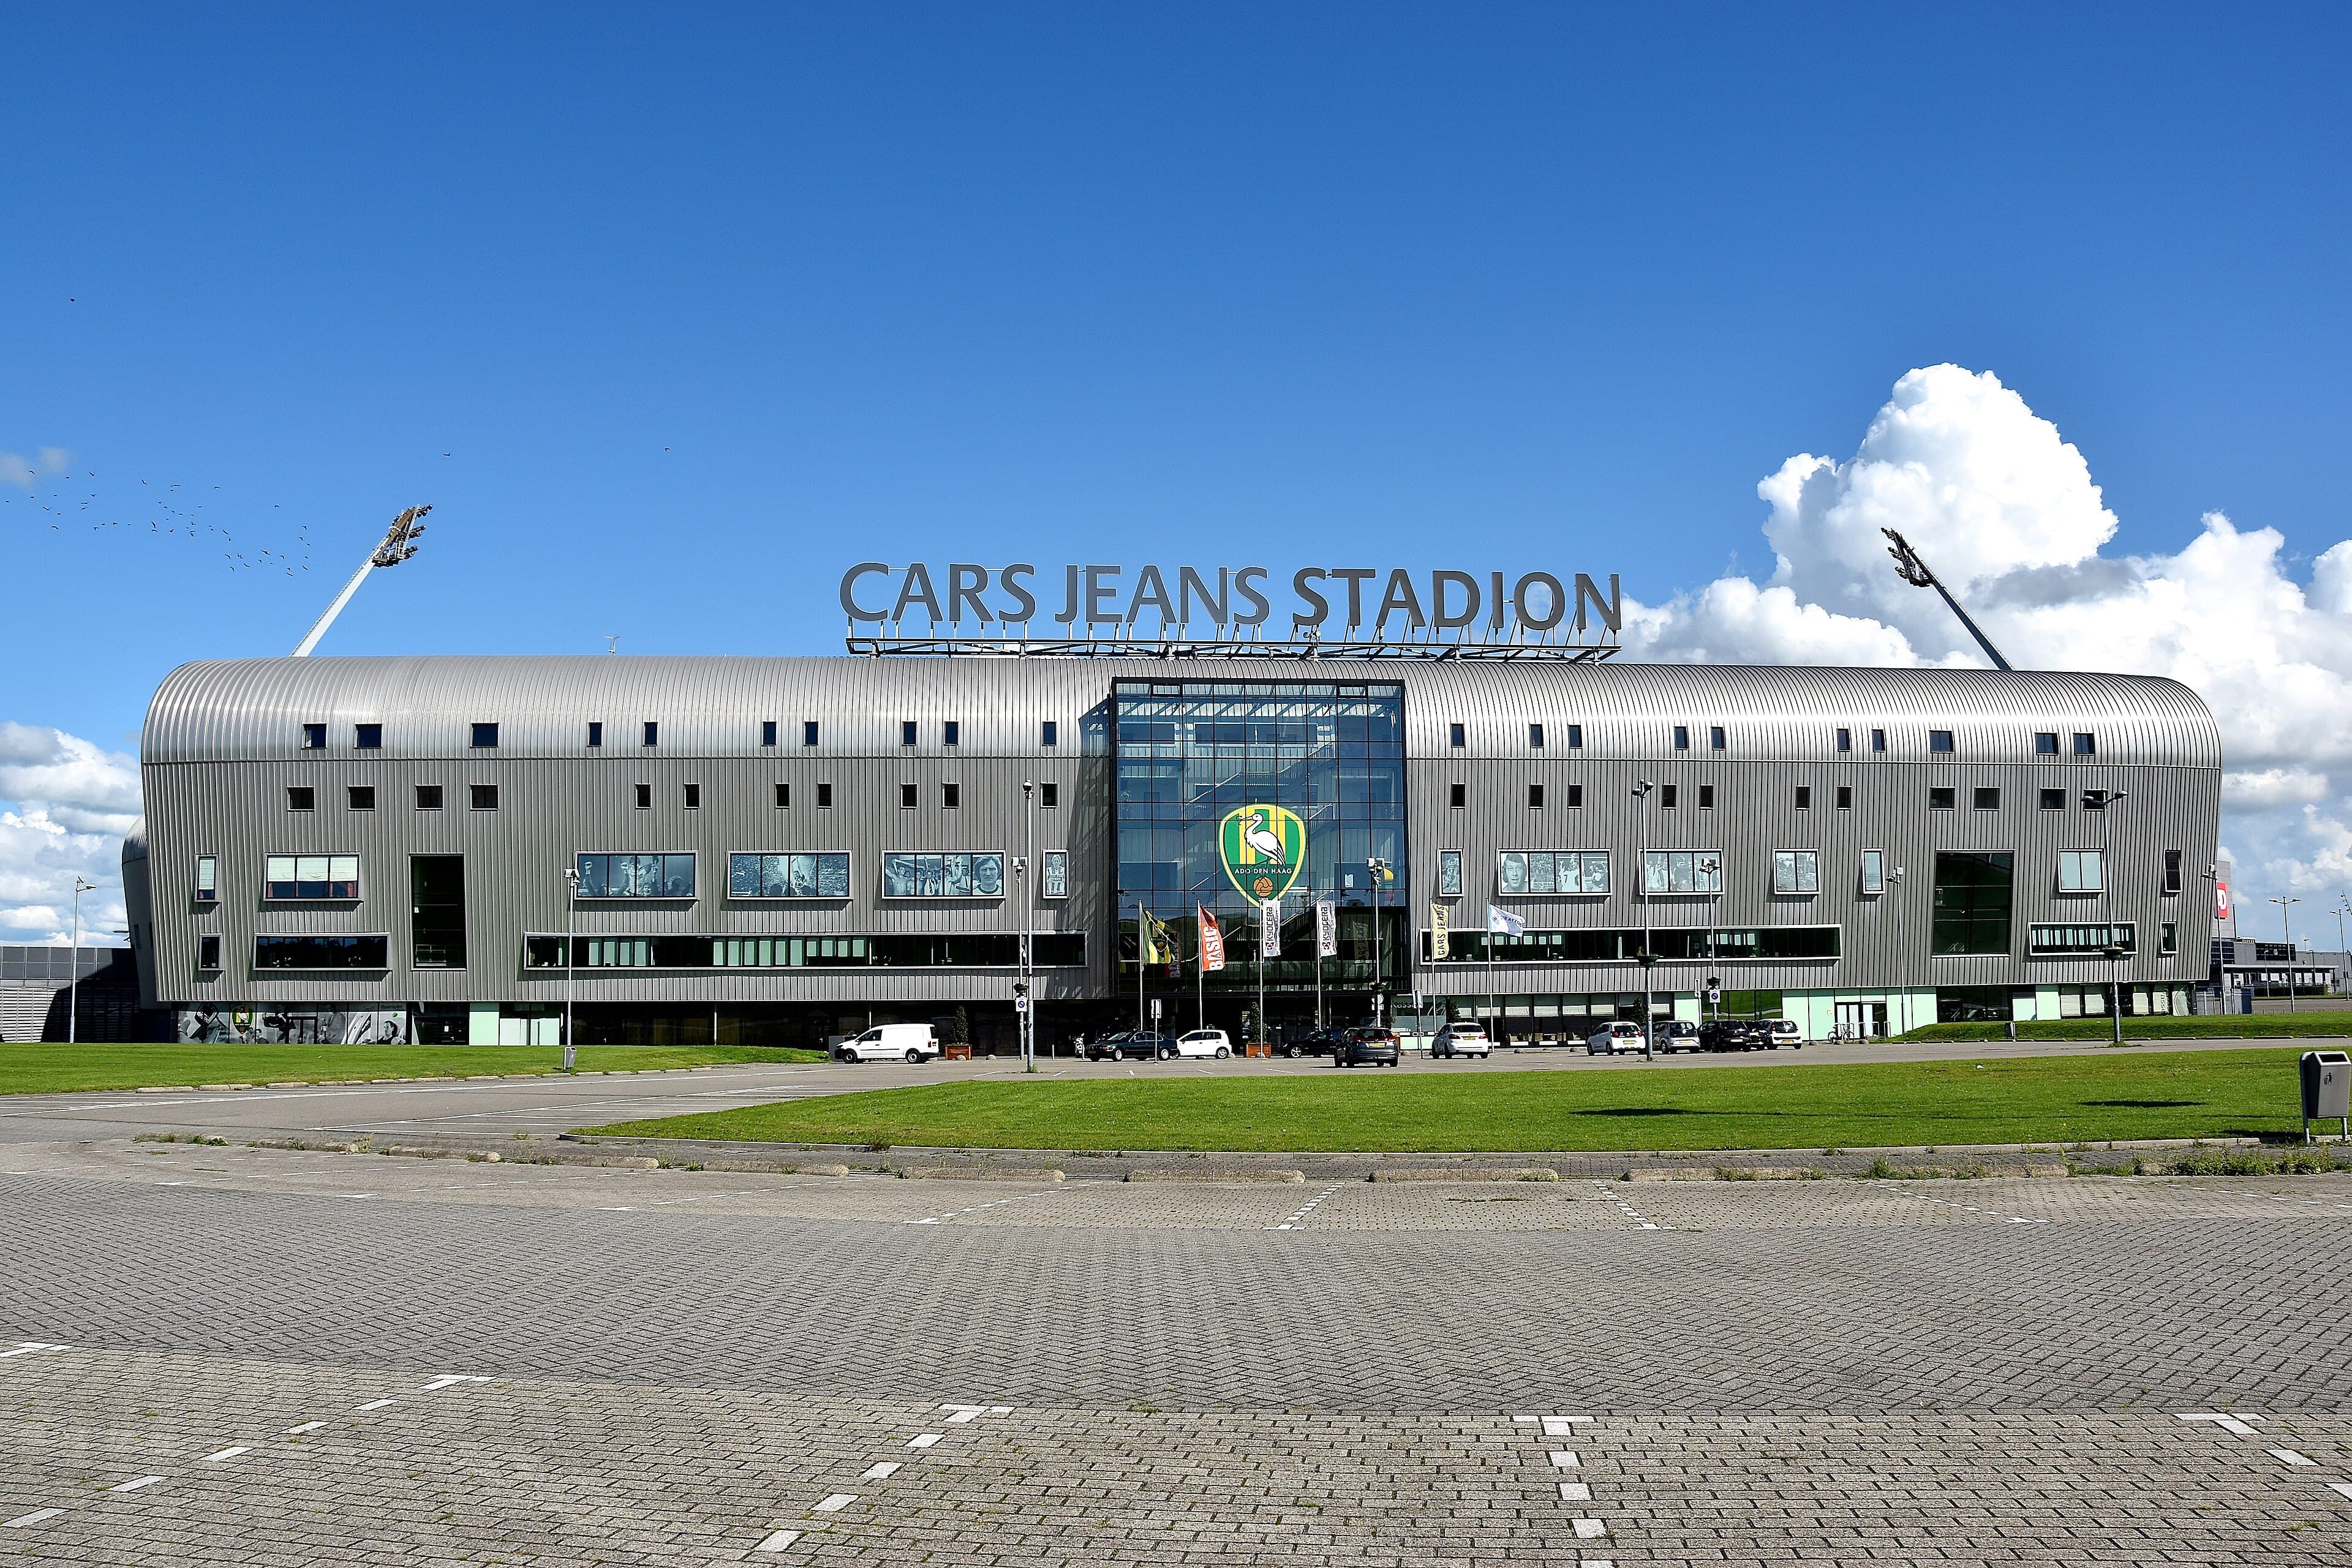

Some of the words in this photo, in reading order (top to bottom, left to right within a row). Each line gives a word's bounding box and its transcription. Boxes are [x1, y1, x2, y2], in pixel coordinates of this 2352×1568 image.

[839, 562, 1036, 622] CARS
[1054, 564, 1270, 625] JEANS
[1292, 567, 1621, 631] STADION
[1321, 907, 1329, 941] KYOCERA
[1437, 905, 1446, 930] JEANS
[1203, 926, 1224, 970] BASIC
[1437, 933, 1446, 955] CARS
[1391, 1000, 1414, 1008] Kass
